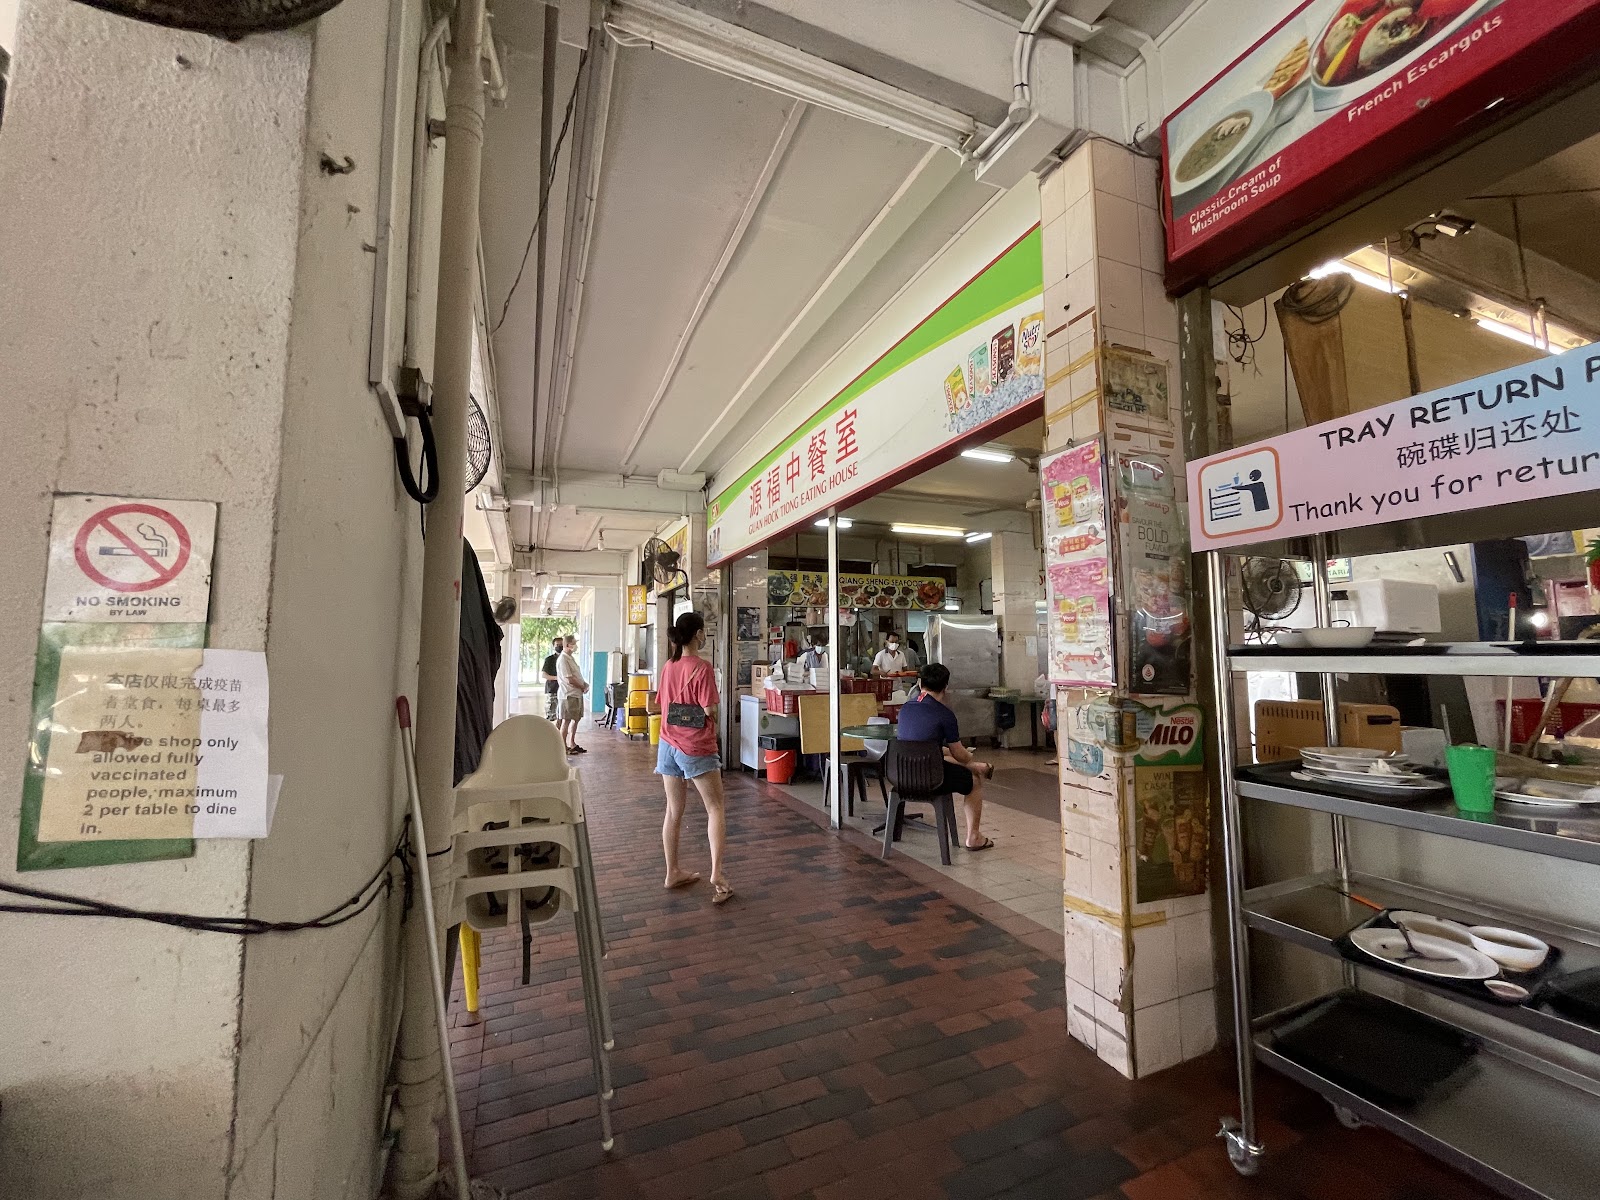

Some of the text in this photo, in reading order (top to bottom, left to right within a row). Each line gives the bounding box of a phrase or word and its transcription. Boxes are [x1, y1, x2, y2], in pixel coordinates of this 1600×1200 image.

[1347, 15, 1502, 122] French Escargots
[1189, 155, 1282, 224] Classic Cream of
[1191, 173, 1282, 235] Mushroom Soup
[1318, 413, 1395, 450] TRAY
[1410, 366, 1565, 429] RETURN
[1396, 405, 1582, 469] 碗碟归还处
[749, 408, 859, 519] 源福中餐室
[763, 509, 779, 526] HOCK
[779, 496, 799, 517] TIONG
[800, 480, 827, 506] EATING
[829, 461, 859, 490] HOUSE
[1288, 451, 1600, 522] Thank you for retur
[1138, 525, 1169, 544] BOLD
[838, 577, 865, 586] QIANG
[865, 578, 890, 587] SHENG
[76, 596, 181, 607] NO SMOKING
[158, 736, 202, 750] shop
[207, 737, 239, 751] only
[1144, 723, 1194, 746] MILO
[92, 752, 204, 767] allowed fully
[91, 769, 187, 781] vaccinated
[1153, 772, 1171, 780] WIN
[86, 786, 238, 801] people, maximum
[83, 803, 237, 819] 2 per table to dine
[80, 823, 102, 835] in.
